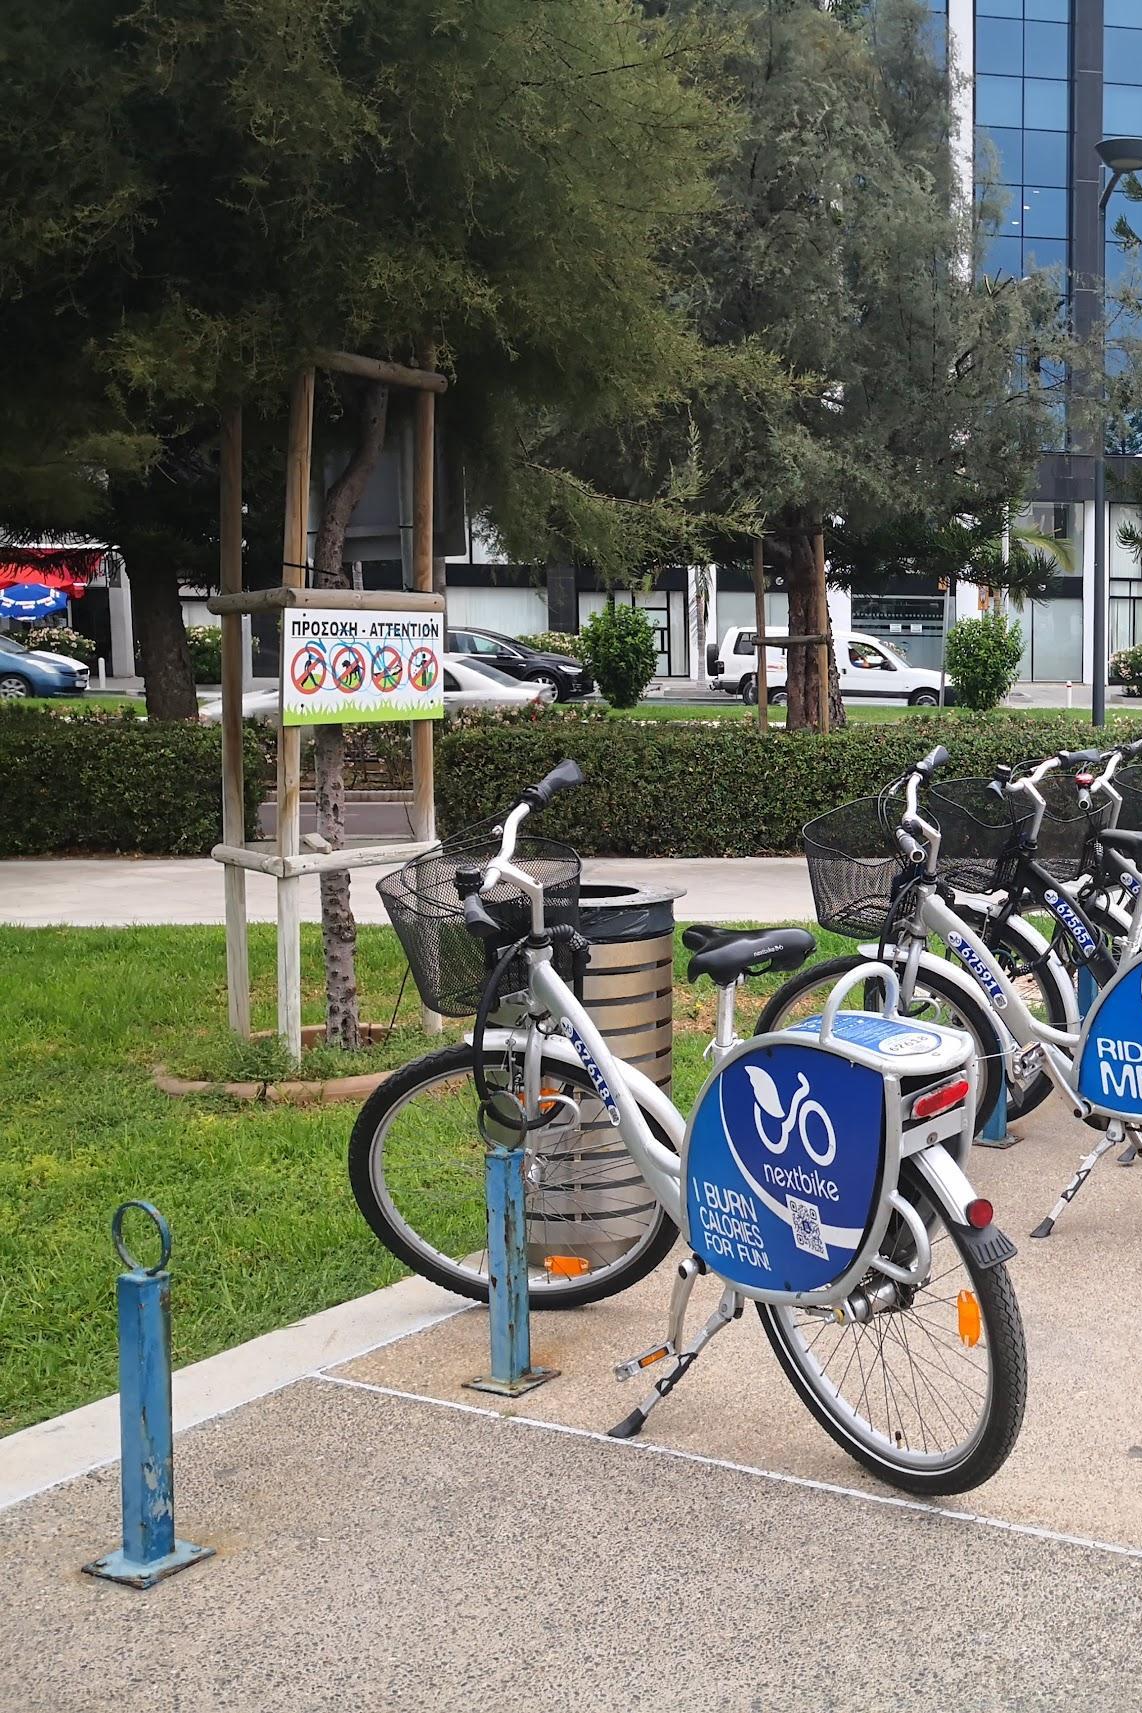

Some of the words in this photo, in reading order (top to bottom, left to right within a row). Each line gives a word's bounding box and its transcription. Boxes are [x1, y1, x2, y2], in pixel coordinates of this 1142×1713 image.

[291, 620, 358, 637] ΠΡΟΣΟΧΗ
[369, 622, 439, 638] ATTENTION
[1056, 902, 1091, 945] 67565
[960, 947, 998, 991] 67591
[573, 1040, 610, 1101] 67618
[692, 1176, 701, 1202] I
[703, 1181, 758, 1223] BURN
[763, 1163, 840, 1202] nextbike
[700, 1206, 765, 1249] CALORIES
[703, 1230, 735, 1259] FOR
[737, 1245, 772, 1272] FUN!
